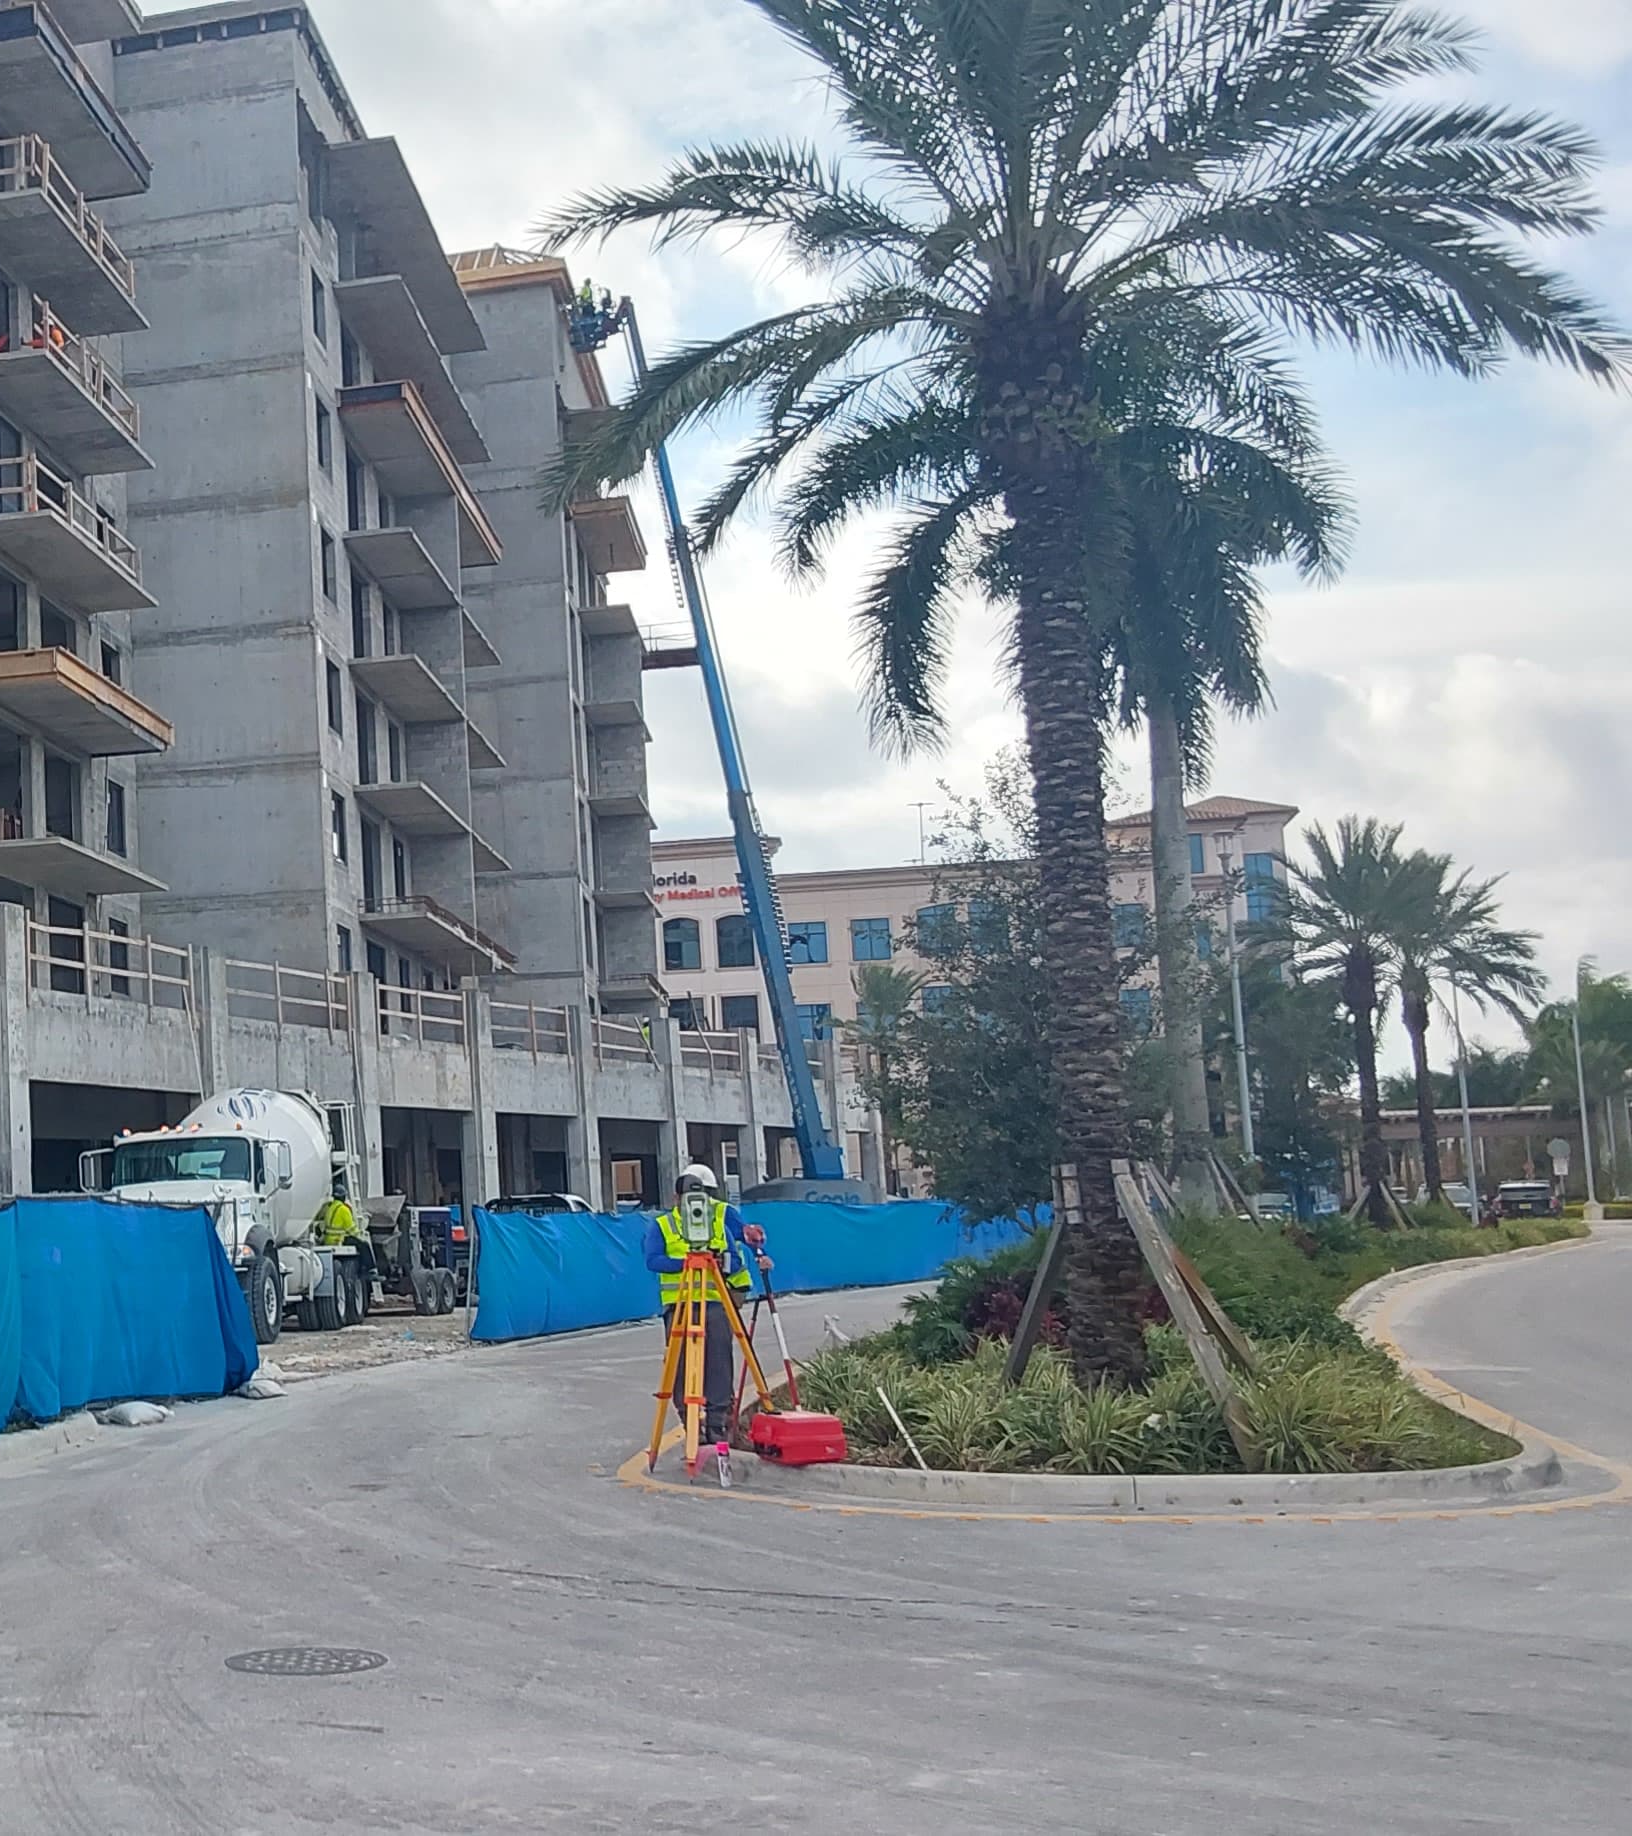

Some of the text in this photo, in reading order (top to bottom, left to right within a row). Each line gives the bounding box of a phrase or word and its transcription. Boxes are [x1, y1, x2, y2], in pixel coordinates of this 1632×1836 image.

[652, 871, 697, 887] lorida
[667, 888, 714, 900] Medical
[718, 885, 741, 898] Off
